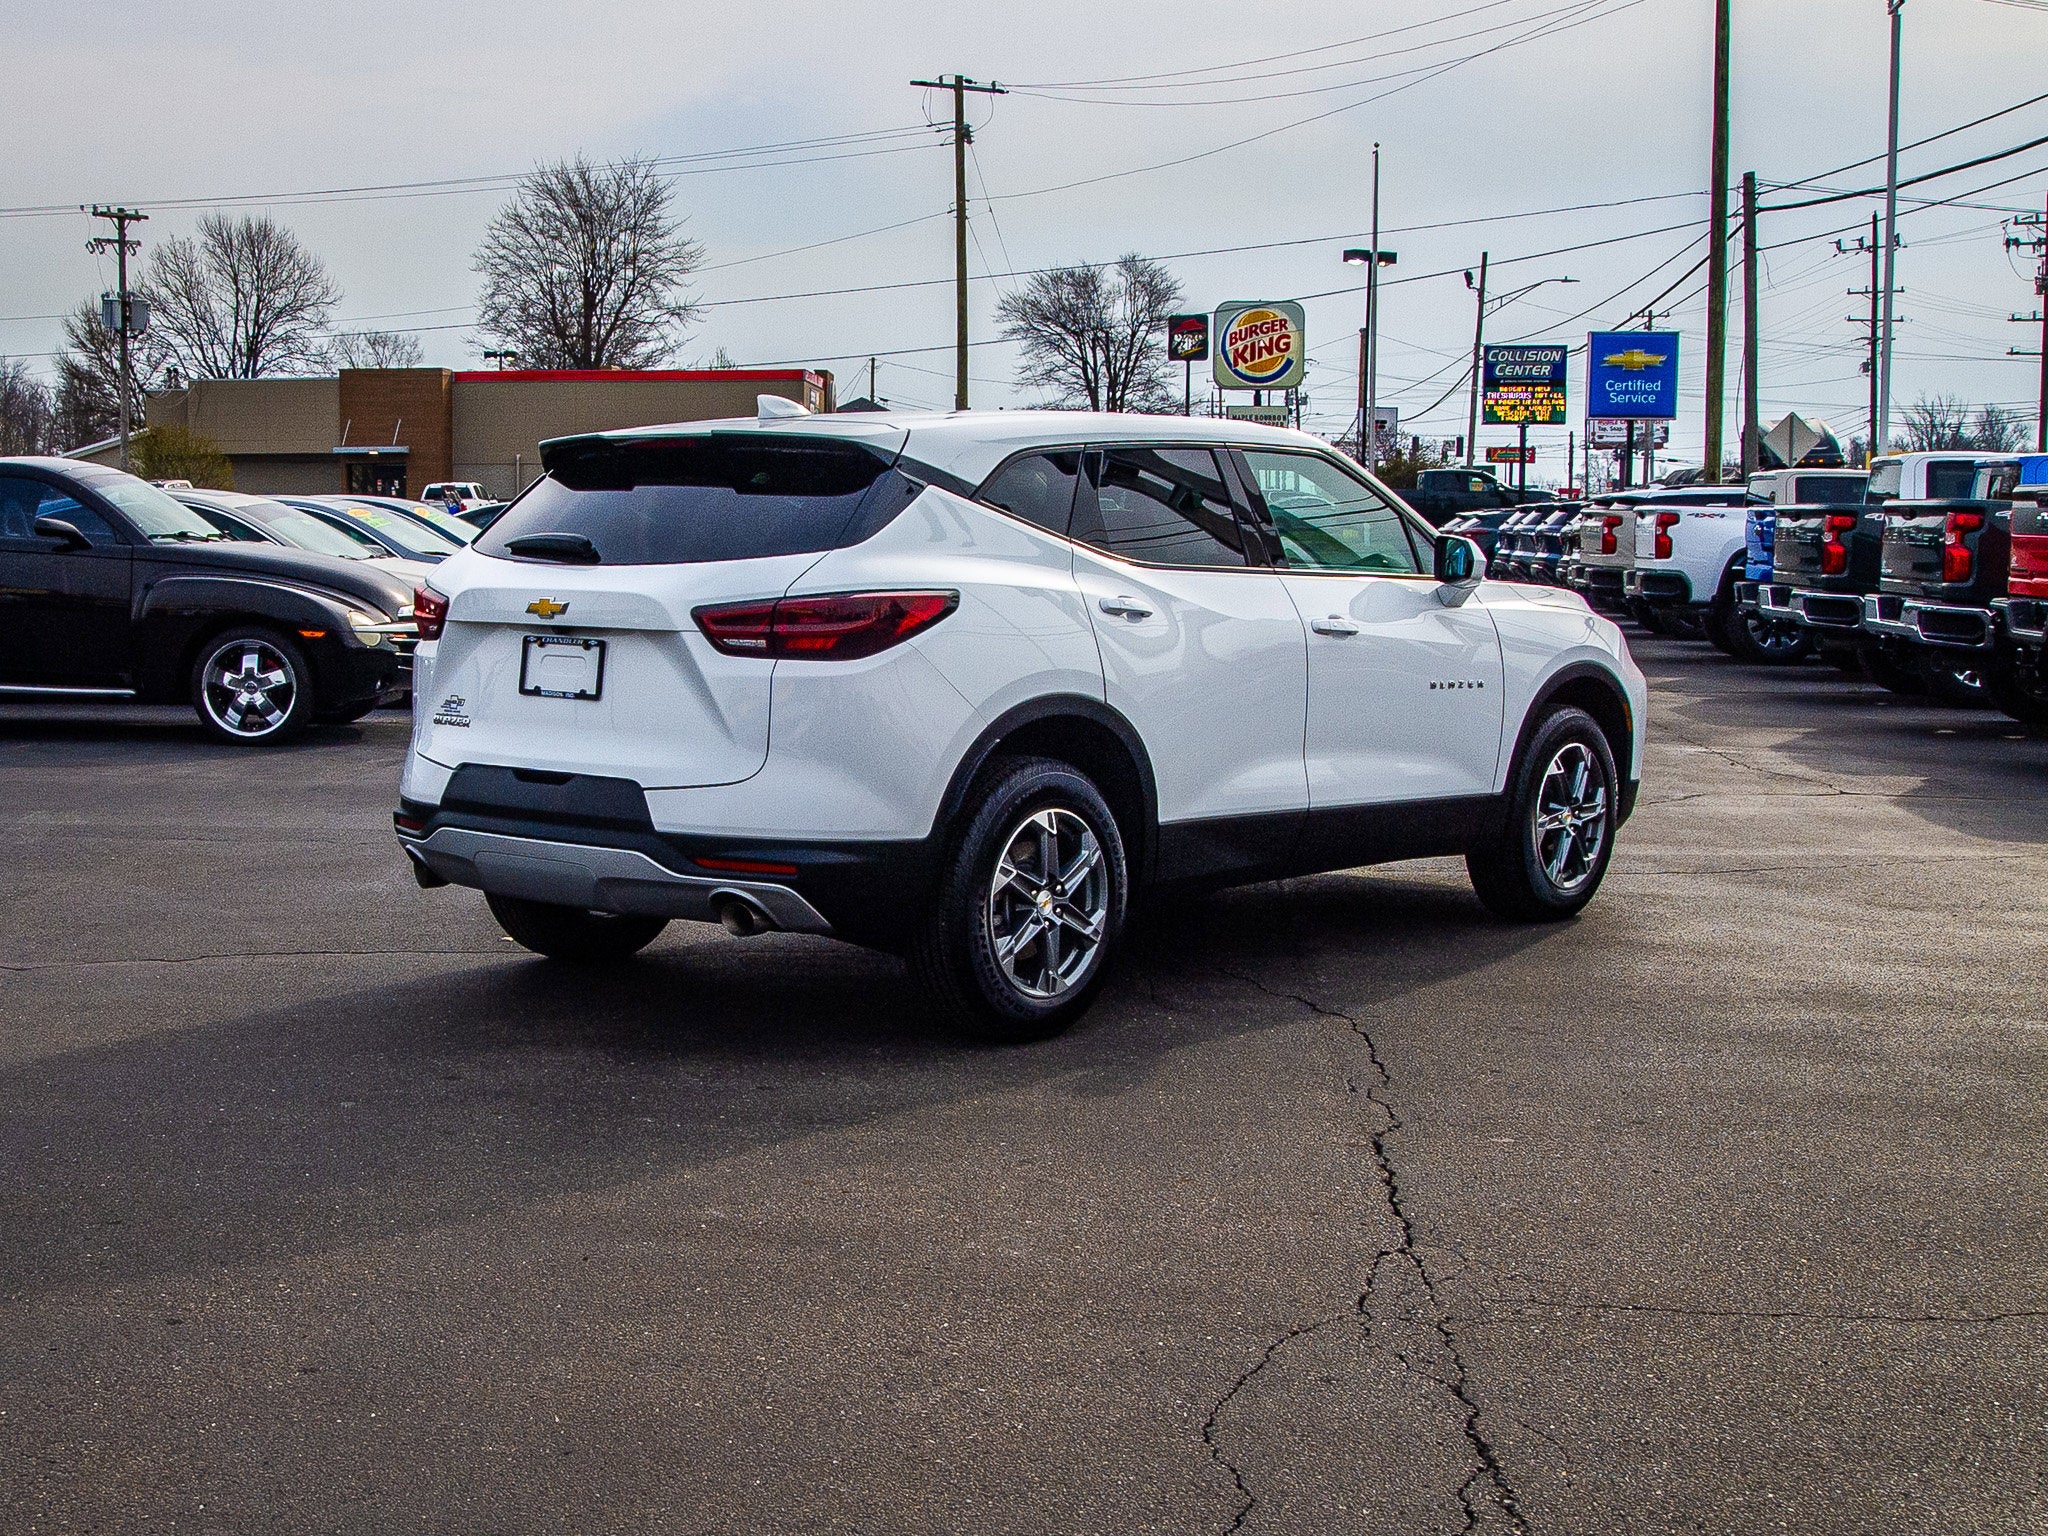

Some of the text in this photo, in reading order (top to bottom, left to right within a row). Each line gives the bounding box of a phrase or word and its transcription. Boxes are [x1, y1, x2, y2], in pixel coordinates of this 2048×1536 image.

[1228, 318, 1289, 347] BURGER
[1232, 333, 1292, 369] KING
[1488, 349, 1562, 362] COLLISION
[1495, 364, 1551, 376] CENTER
[1605, 379, 1662, 391] Certified
[1609, 392, 1656, 404] Service
[541, 637, 584, 645] CHANDLER
[1429, 679, 1485, 690] BLAZER
